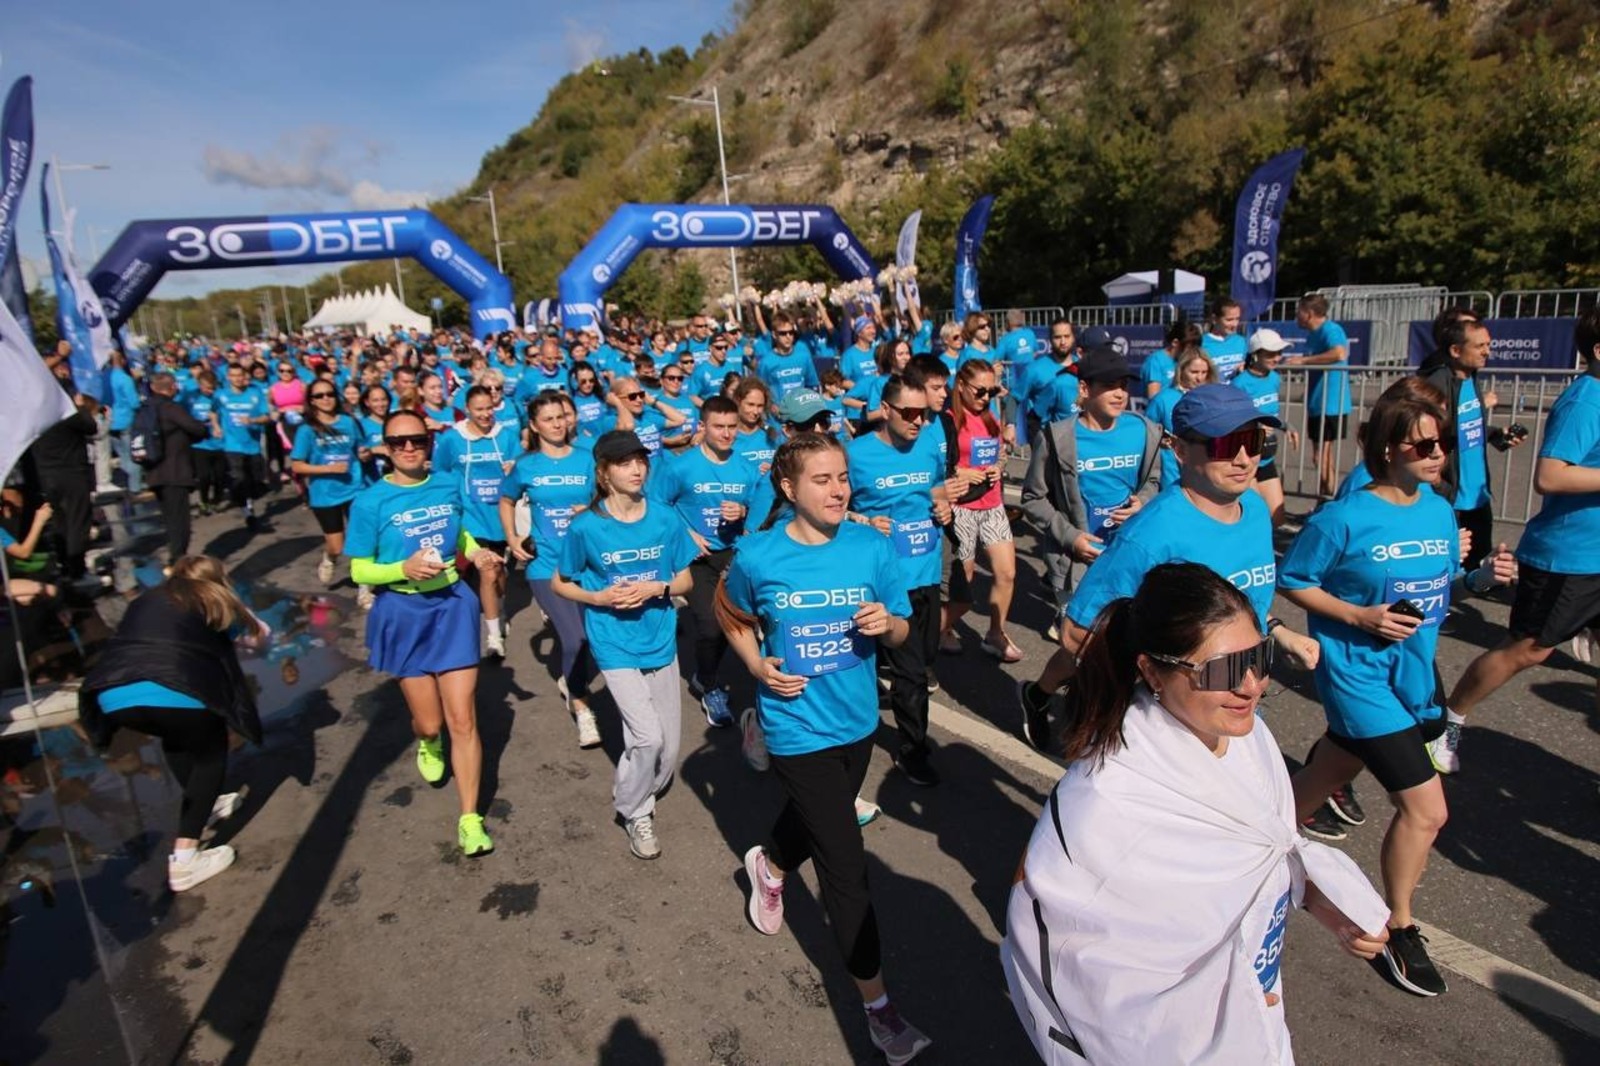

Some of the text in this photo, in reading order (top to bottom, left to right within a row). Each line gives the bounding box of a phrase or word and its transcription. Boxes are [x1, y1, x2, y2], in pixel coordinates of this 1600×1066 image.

[1247, 182, 1268, 247] ЗДОРОВОЕ
[1259, 182, 1282, 247] ОТЕЧСТВО
[1490, 338, 1540, 349] ОРОВОЕ
[1489, 350, 1541, 361] ЕЧЕСТВО
[976, 448, 996, 458] 336
[420, 533, 444, 549] 88
[908, 532, 929, 545] 121
[795, 638, 854, 659] 1523
